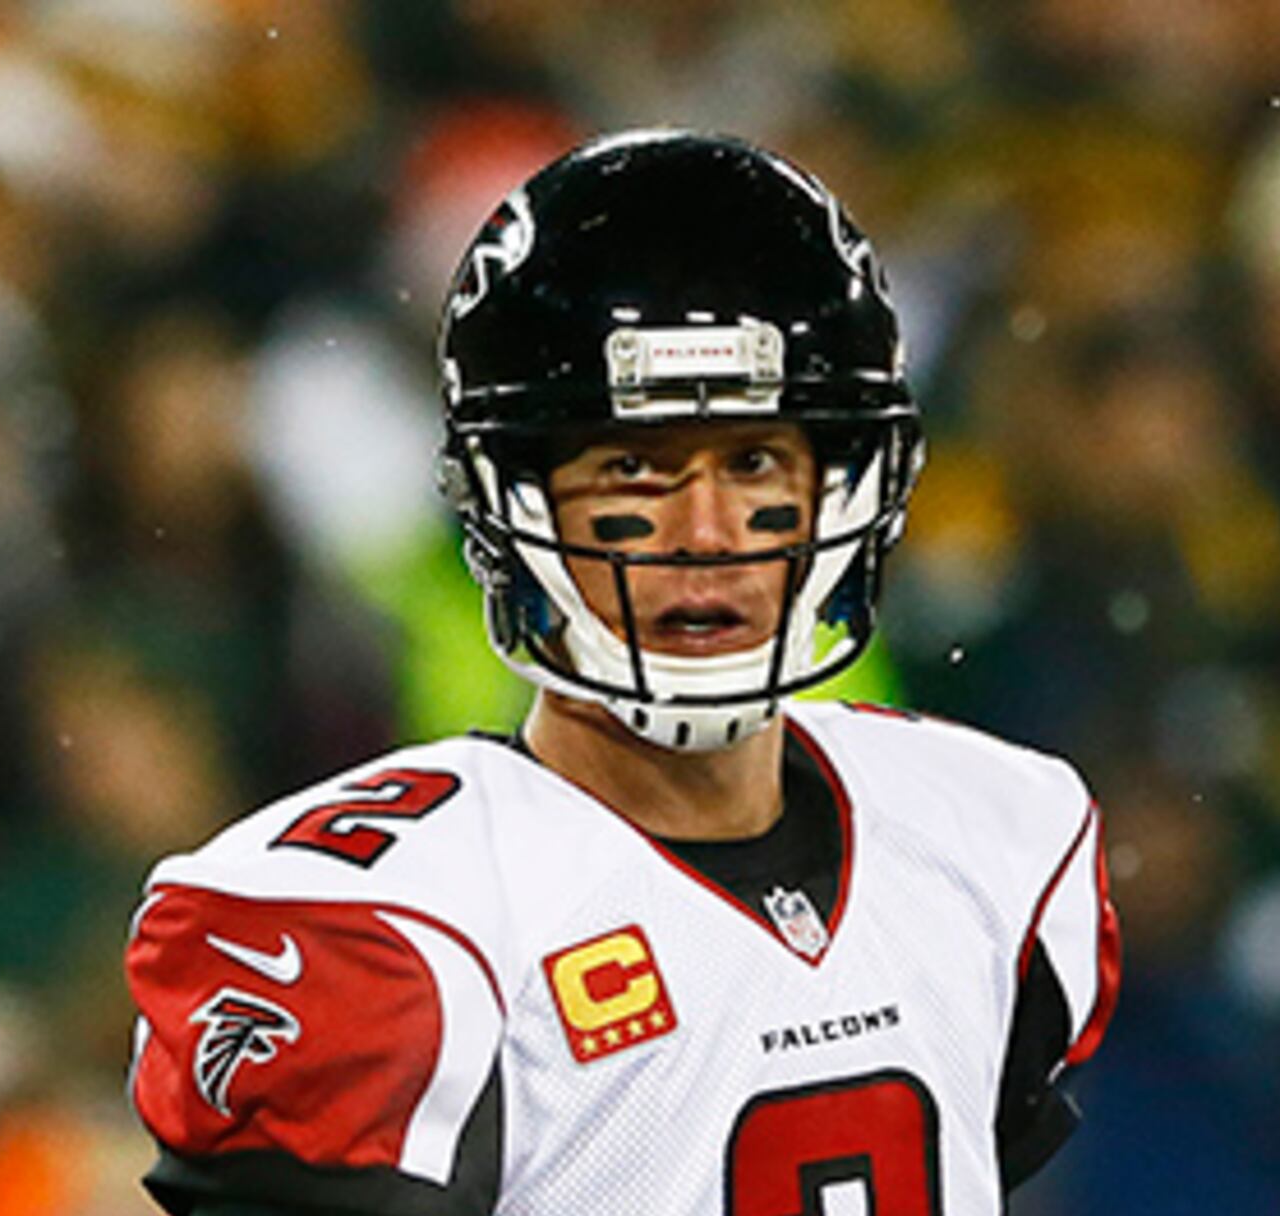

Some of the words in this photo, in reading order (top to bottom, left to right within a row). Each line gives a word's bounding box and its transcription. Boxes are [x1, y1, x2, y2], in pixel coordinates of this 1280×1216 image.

[267, 769, 462, 869] 2
[552, 932, 659, 1032] C
[760, 1002, 900, 1053] FALCONS
